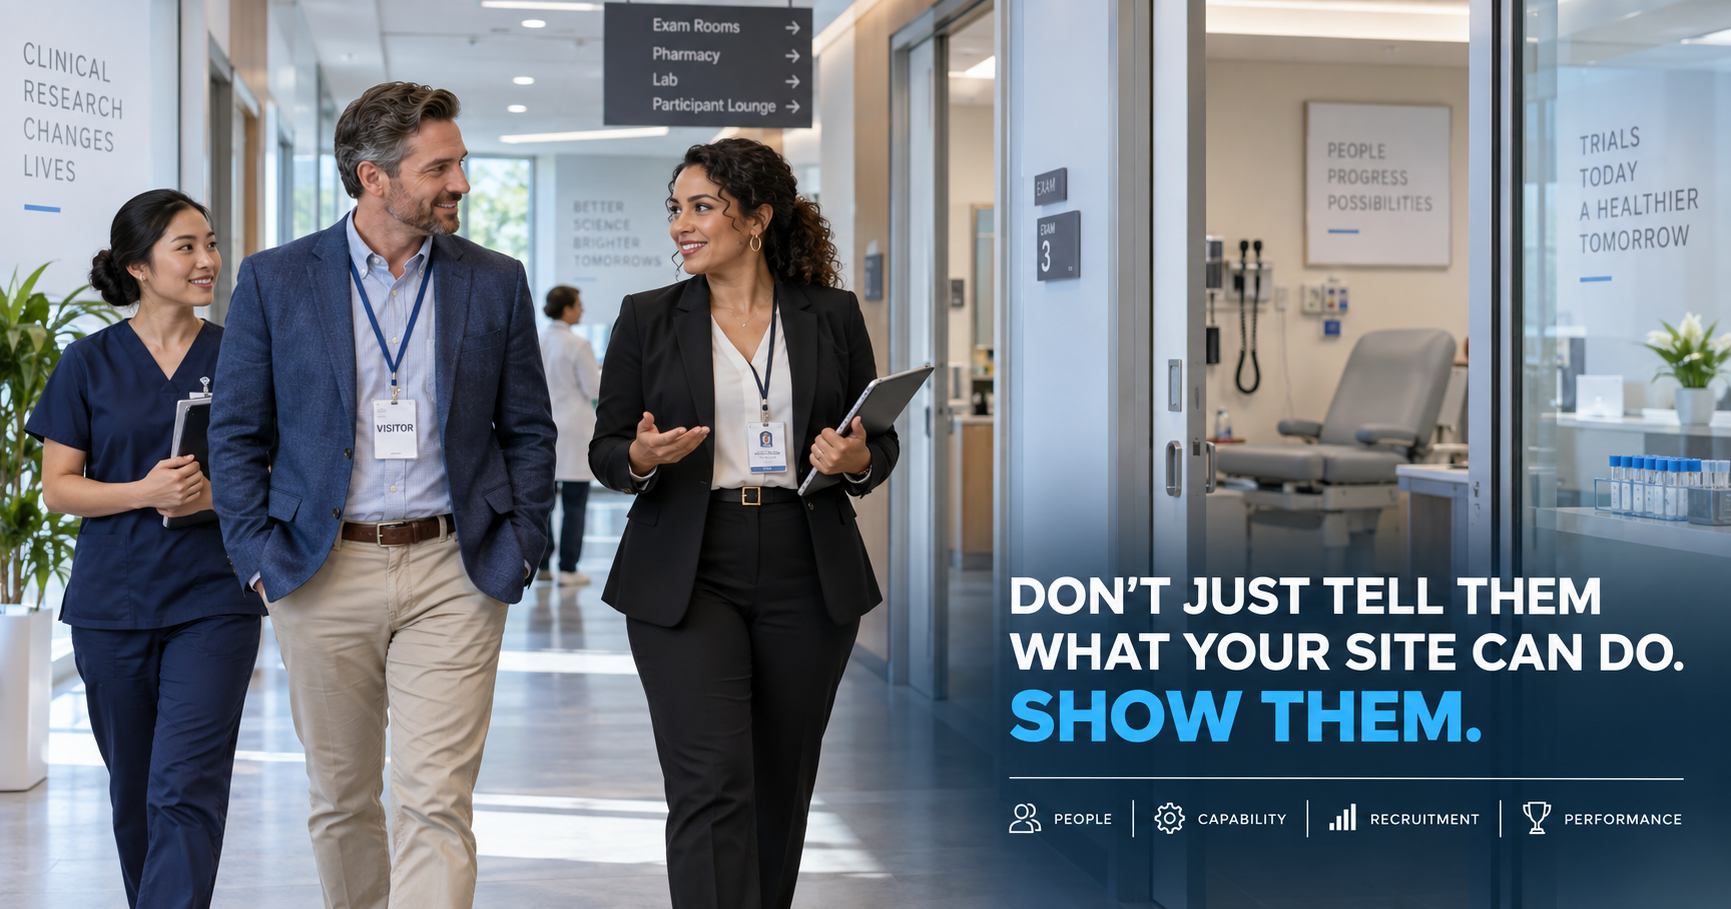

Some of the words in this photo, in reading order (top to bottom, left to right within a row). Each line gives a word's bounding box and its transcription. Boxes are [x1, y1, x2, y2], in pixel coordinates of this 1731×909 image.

[653, 18, 690, 32] Exam
[694, 19, 740, 33] Rooms
[23, 42, 110, 83] CLINICAL
[653, 47, 720, 64] Pharmacy
[653, 73, 678, 86] Lab
[24, 79, 122, 119] RESEARCH
[653, 98, 724, 114] Participant
[728, 99, 776, 115] Lounge
[23, 117, 114, 152] CHANGES
[1580, 126, 1640, 155] TRIALS
[1328, 142, 1386, 160] PEOPLE
[24, 154, 76, 182] LIVES
[1328, 168, 1409, 187] PROGRESS
[1580, 160, 1638, 188] TODAY
[1037, 177, 1056, 197] EXAM
[573, 200, 625, 213] BETTER
[1328, 194, 1433, 213] POSSIBILITIES
[1579, 201, 1590, 221] A
[1598, 187, 1699, 220] HEALTHIER
[573, 219, 630, 232] SCIENCE
[573, 236, 641, 249] BRIGHTER
[1580, 224, 1690, 254] TOMORROW
[574, 254, 662, 268] TOMORROWS
[1041, 240, 1051, 273] 3
[376, 423, 414, 433] VISITOR
